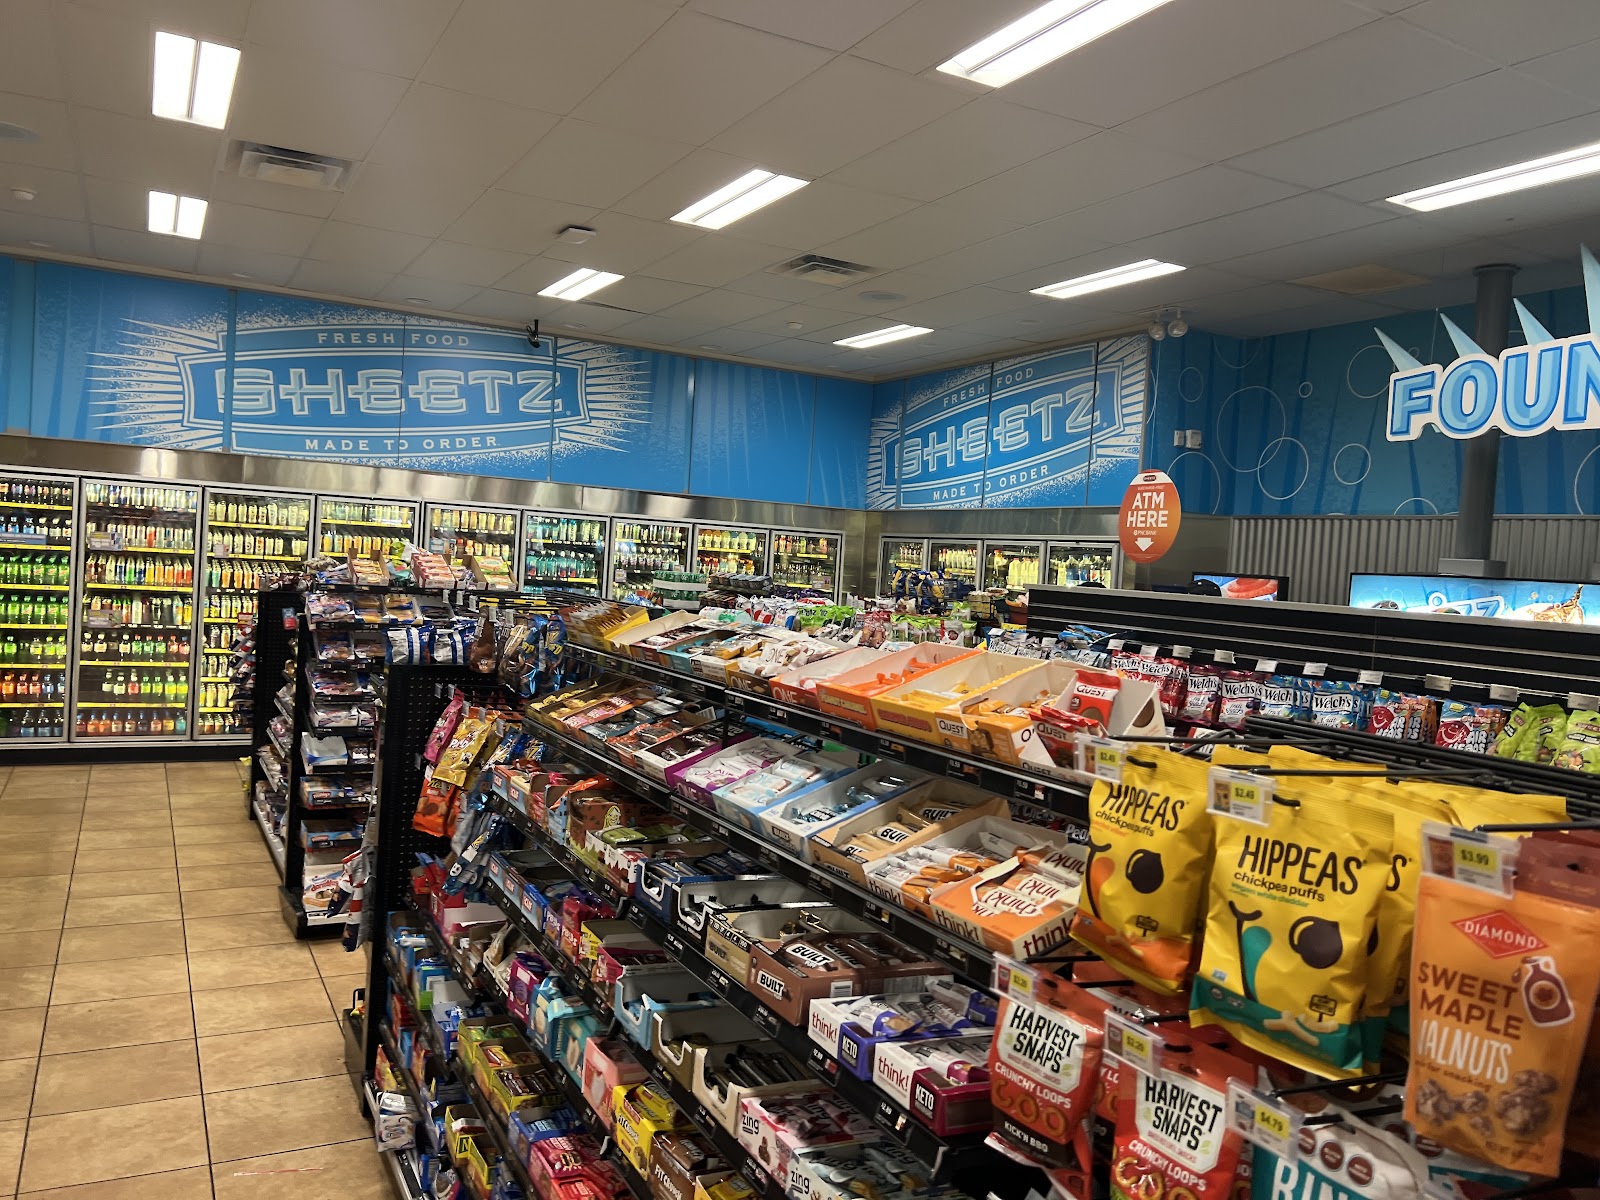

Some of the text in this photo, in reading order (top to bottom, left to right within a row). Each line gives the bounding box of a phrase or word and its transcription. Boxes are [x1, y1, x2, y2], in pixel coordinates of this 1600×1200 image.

[317, 333, 469, 346] FRESH FOOD
[217, 368, 563, 415] SHEETZ
[943, 367, 1034, 408] FRESH FOOD
[305, 436, 498, 451] MADE TO ORDER
[895, 381, 1100, 479] SHEETZ
[933, 464, 1049, 501] MADE TO ORDER
[1132, 491, 1165, 509] ATM
[1126, 510, 1169, 528] HERE
[1141, 662, 1170, 675] Welch's
[1077, 685, 1106, 697] QUEST
[1189, 677, 1218, 690] Welch's
[1225, 683, 1255, 696] Welch's
[1314, 696, 1352, 709] Welch's
[939, 719, 964, 735] QUEST
[1037, 723, 1067, 740] QUEST
[1466, 730, 1487, 744] AIR
[1101, 782, 1185, 831] HIPPEAS
[1238, 834, 1363, 895] HIPPEAS
[868, 878, 902, 903] think!
[1234, 871, 1325, 902] chickpea puffs
[935, 909, 979, 941] think!
[1465, 920, 1538, 949] DIAMOND
[791, 946, 831, 964] BUILT
[760, 973, 784, 994] BUILT
[1418, 961, 1518, 1007] SWEET
[812, 1011, 838, 1044] think!
[1419, 988, 1525, 1041] MAPLE
[1010, 1005, 1080, 1058] HARVEST
[842, 1035, 858, 1059] KETO
[1013, 1032, 1063, 1074] SNAPS
[878, 1055, 910, 1091] think!
[995, 1061, 1036, 1093] CRUNCHY
[1036, 1085, 1072, 1109] LOOPS
[915, 1084, 935, 1110] KETO
[1145, 1075, 1223, 1133] HARVEST
[742, 1111, 760, 1135] zing
[1004, 1121, 1049, 1153] KICK'N BBQ
[1152, 1106, 1203, 1151] SNAPS
[1128, 1139, 1168, 1170] CRUNCHY
[1167, 1162, 1207, 1192] LOOPS
[791, 1167, 811, 1195] zing
